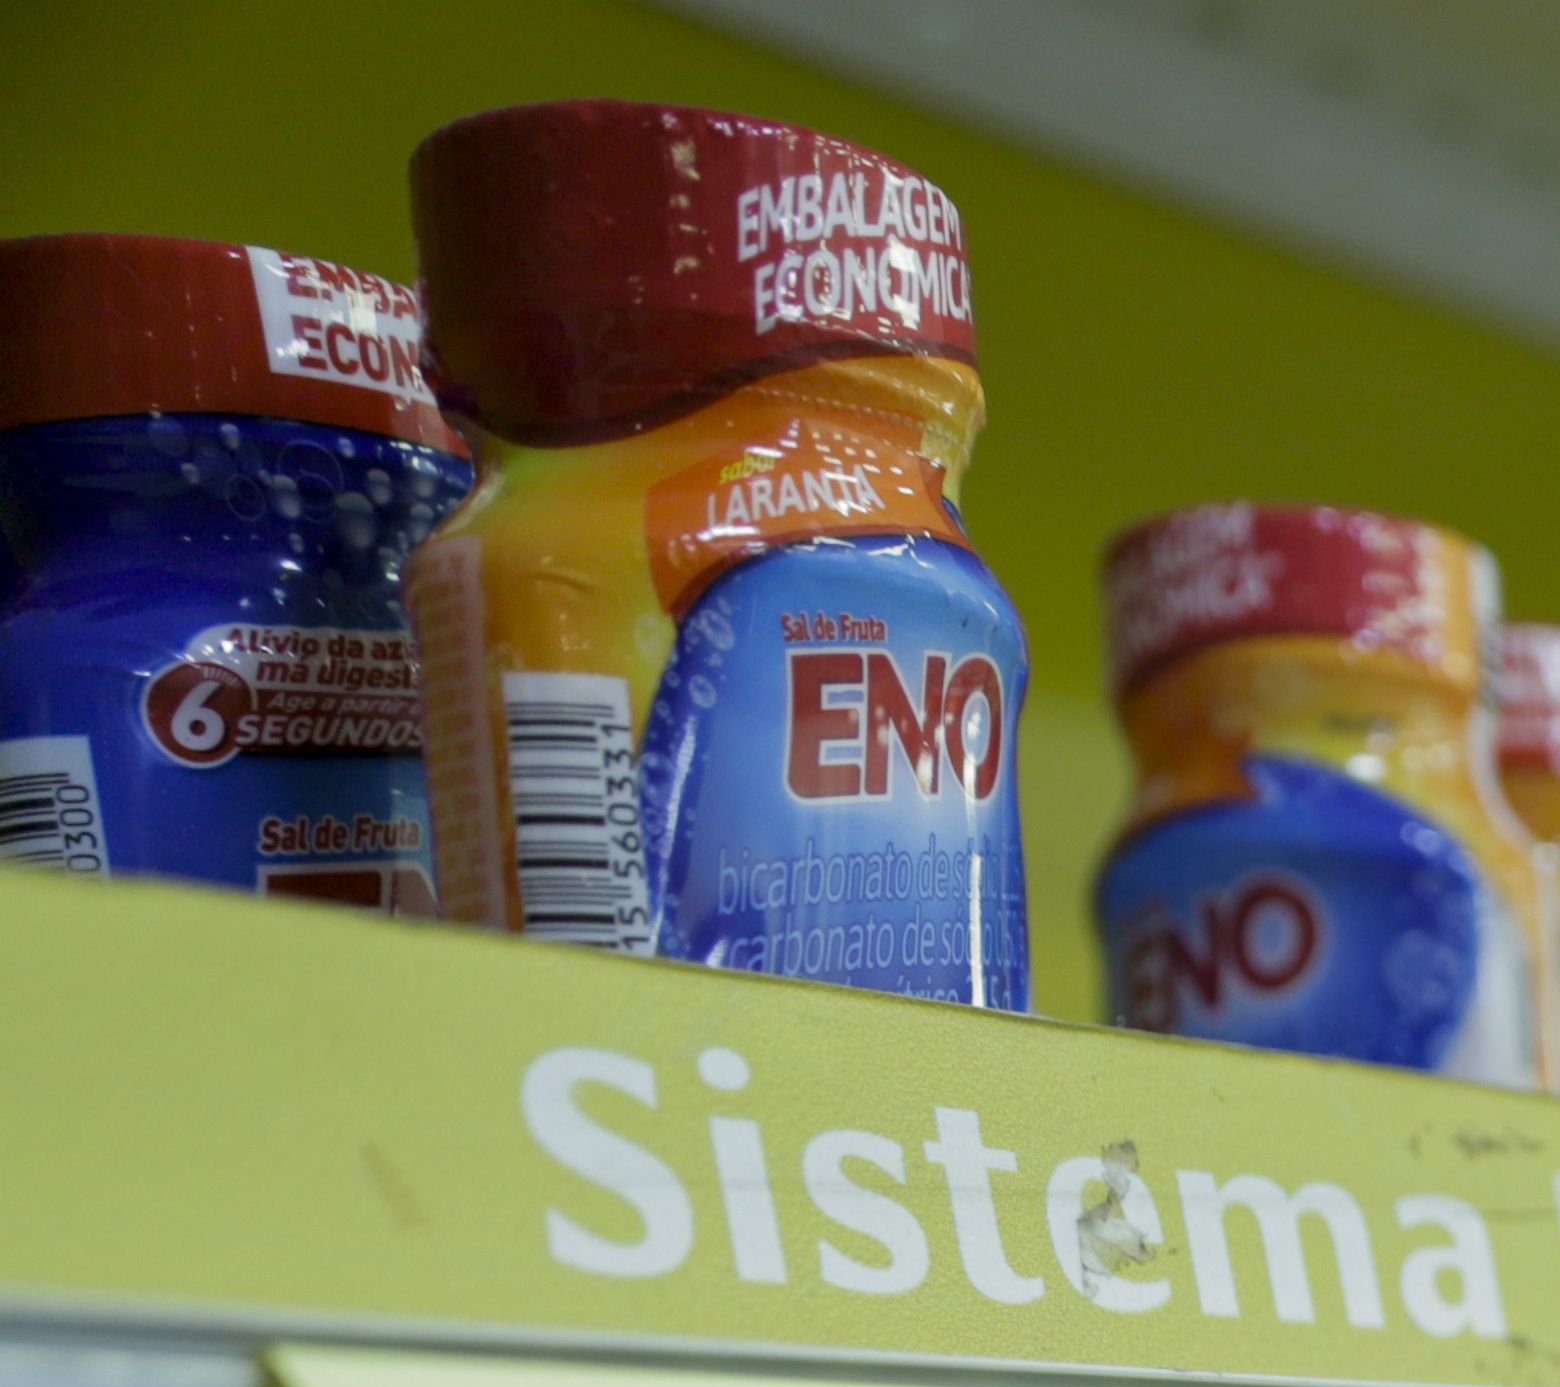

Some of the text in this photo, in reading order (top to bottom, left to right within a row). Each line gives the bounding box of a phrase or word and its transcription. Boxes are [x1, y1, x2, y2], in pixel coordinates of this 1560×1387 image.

[737, 168, 960, 263] EMBALAGEM
[707, 464, 886, 529] LARANJA
[328, 634, 365, 659] da
[780, 610, 888, 642] Sal de Fruta
[170, 680, 226, 752] 6
[786, 648, 1003, 803] ENO
[260, 814, 420, 852] Sal de Fruta
[718, 836, 912, 915] bicarbonato
[917, 832, 949, 899] de
[902, 903, 936, 968] de
[521, 1045, 1509, 1341] Sistema
